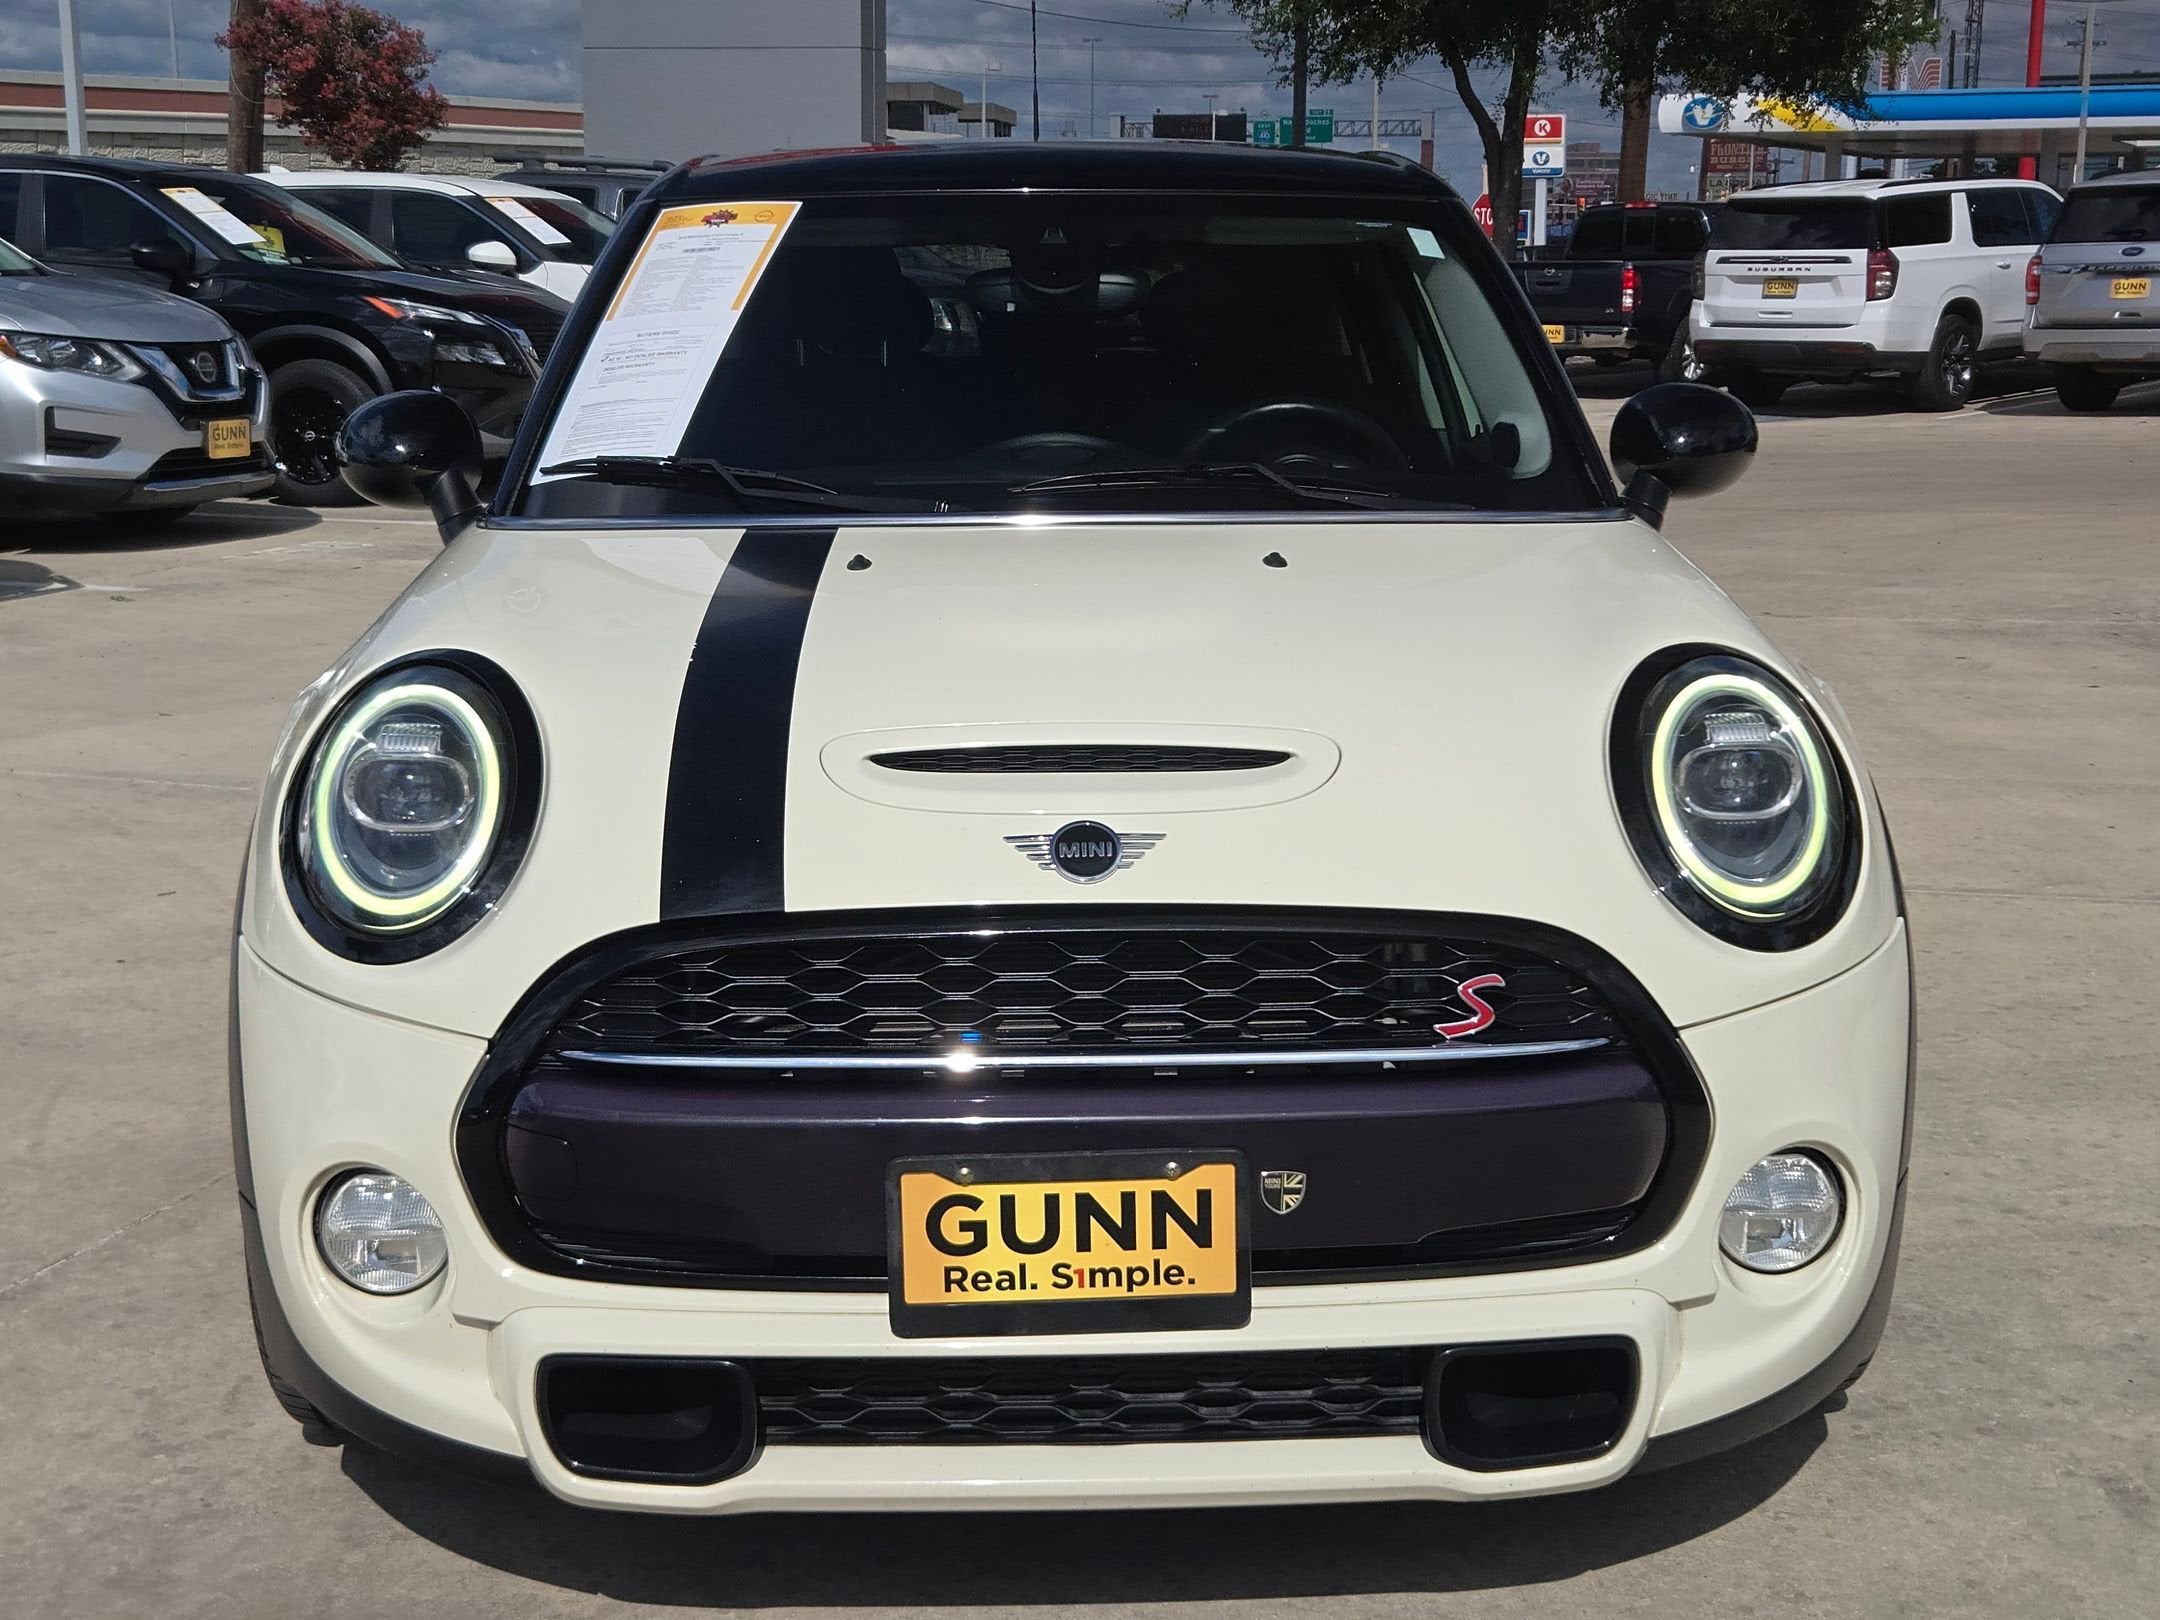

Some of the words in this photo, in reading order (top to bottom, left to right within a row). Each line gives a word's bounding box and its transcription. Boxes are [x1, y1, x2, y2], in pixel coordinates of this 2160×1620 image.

[1283, 118, 1330, 126] Nadoches
[1538, 123, 1548, 133] K
[1474, 208, 1494, 225] STO
[1767, 282, 1794, 290] GUNN
[2114, 282, 2147, 291] GUNN
[213, 426, 246, 440] GUNN
[1059, 841, 1112, 858] MINI
[1433, 973, 1506, 1039] S
[925, 1188, 1212, 1257] GUNN
[943, 1262, 1038, 1293] Real.
